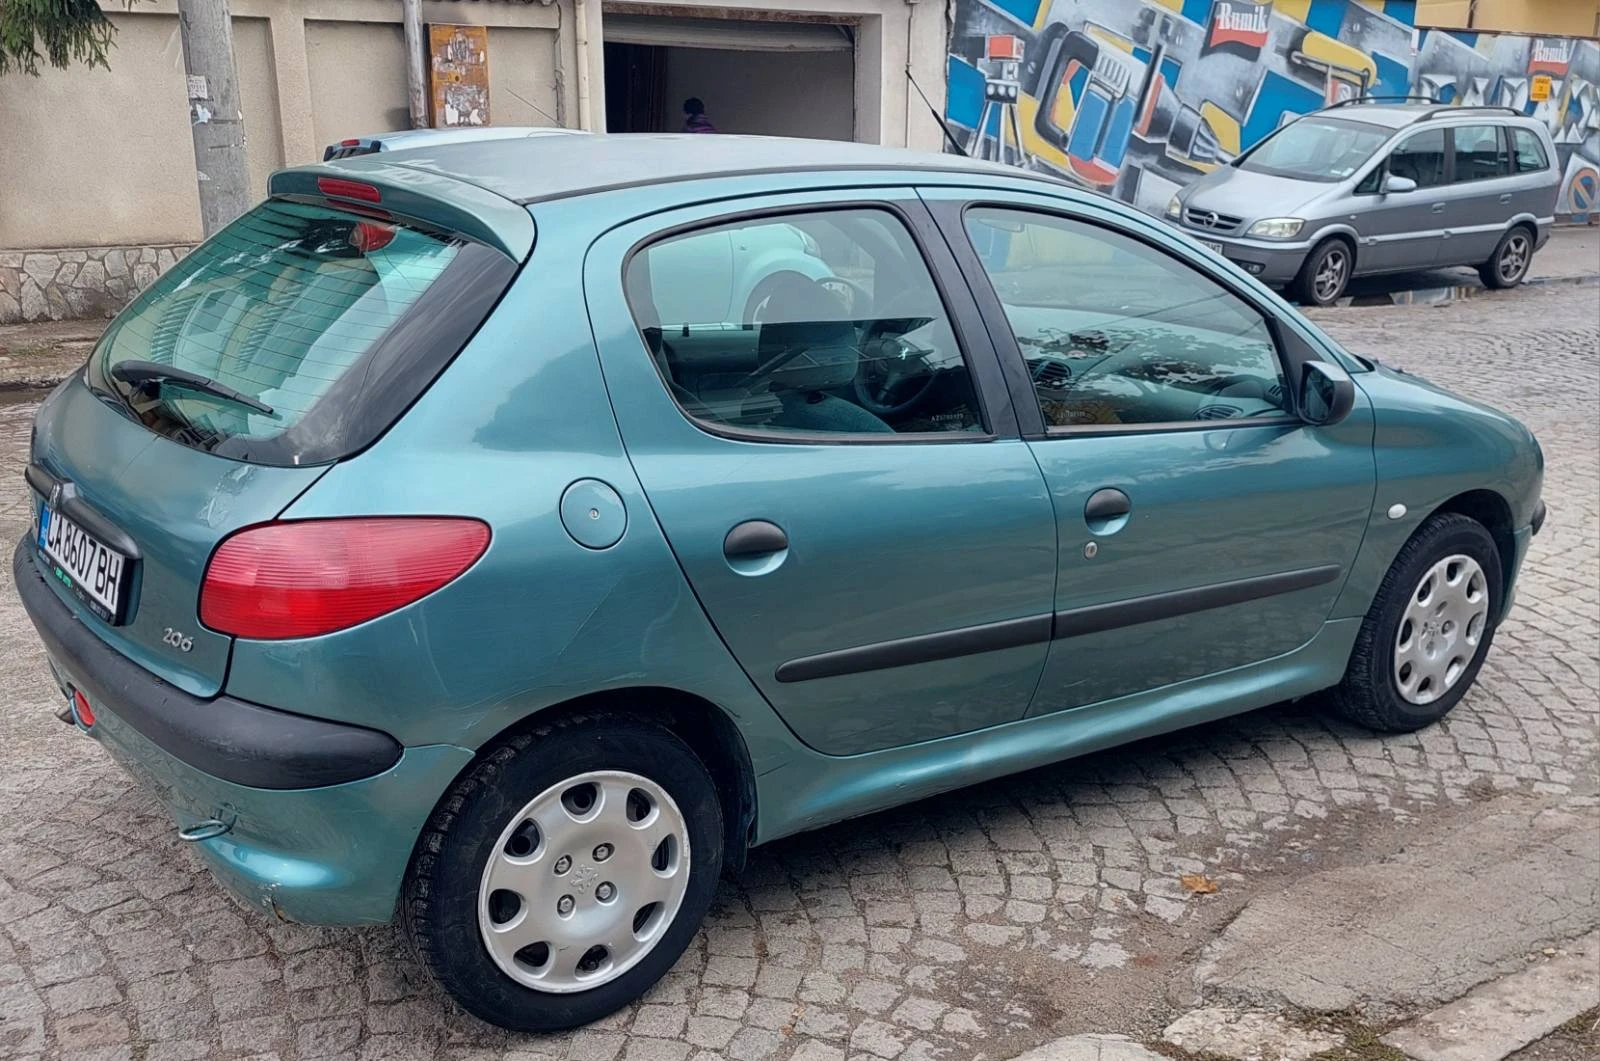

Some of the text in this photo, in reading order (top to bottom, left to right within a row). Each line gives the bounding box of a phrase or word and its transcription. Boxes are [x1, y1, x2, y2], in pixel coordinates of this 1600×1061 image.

[63, 522, 98, 583] 8607
[95, 546, 120, 606] BH
[163, 627, 194, 652] 206
